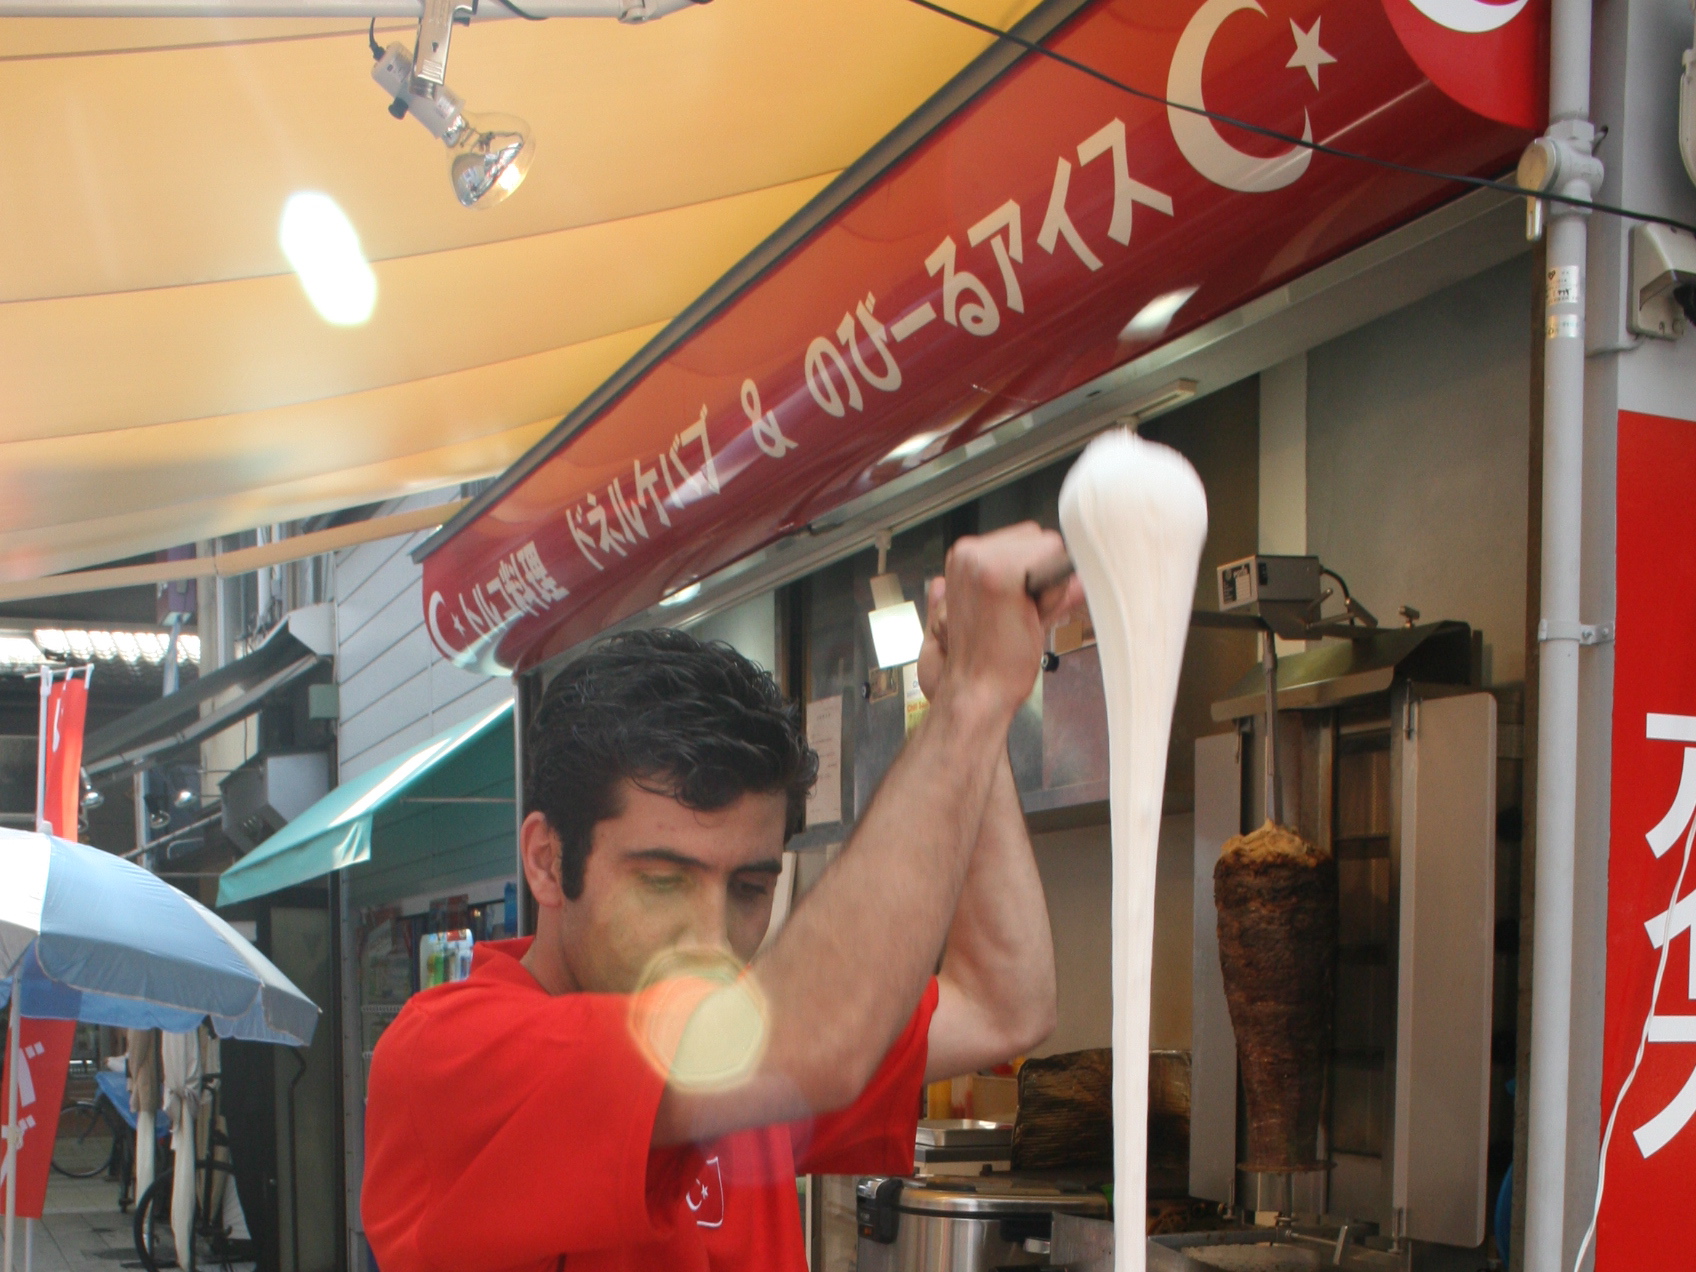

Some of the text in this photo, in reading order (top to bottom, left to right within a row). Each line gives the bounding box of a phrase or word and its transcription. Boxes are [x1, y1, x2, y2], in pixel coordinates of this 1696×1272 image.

[565, 403, 720, 571] ドネルケバブ
[804, 116, 1174, 419] のびーるアイス
